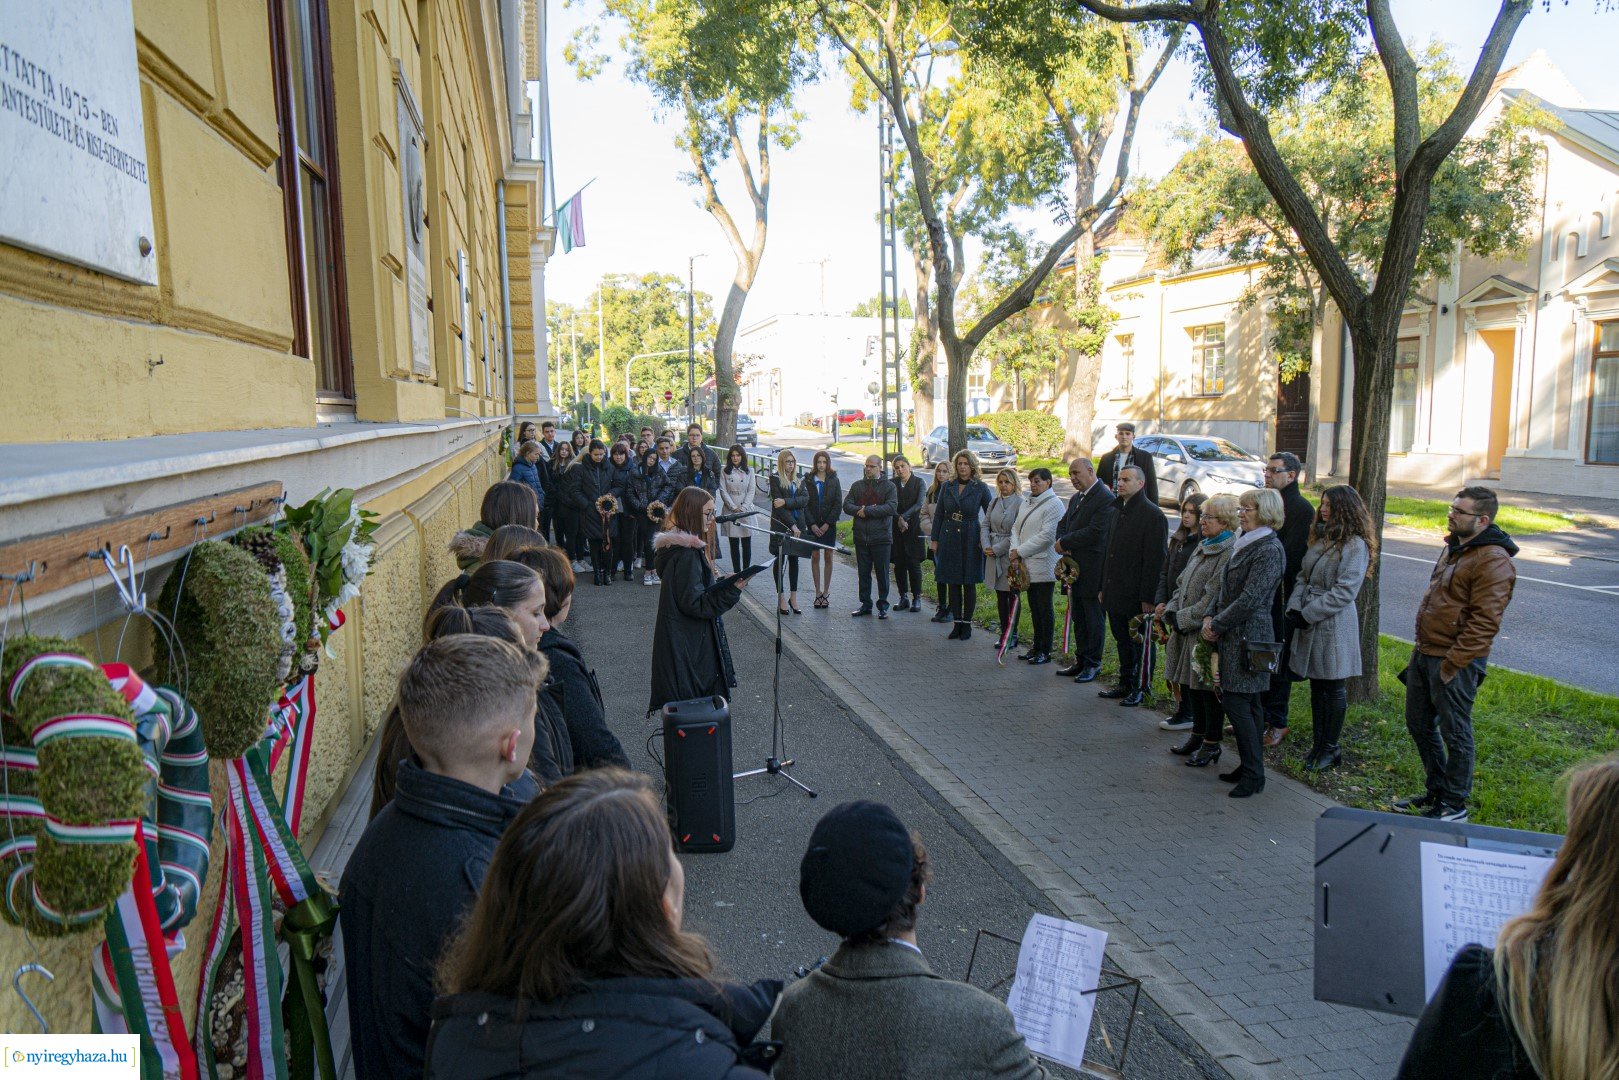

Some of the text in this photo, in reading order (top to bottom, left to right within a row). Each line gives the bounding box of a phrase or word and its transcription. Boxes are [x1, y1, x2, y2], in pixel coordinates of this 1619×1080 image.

[0, 44, 56, 101] TTATTA
[0, 81, 73, 144] ANTESTÜLETE
[74, 117, 86, 150] ÉS
